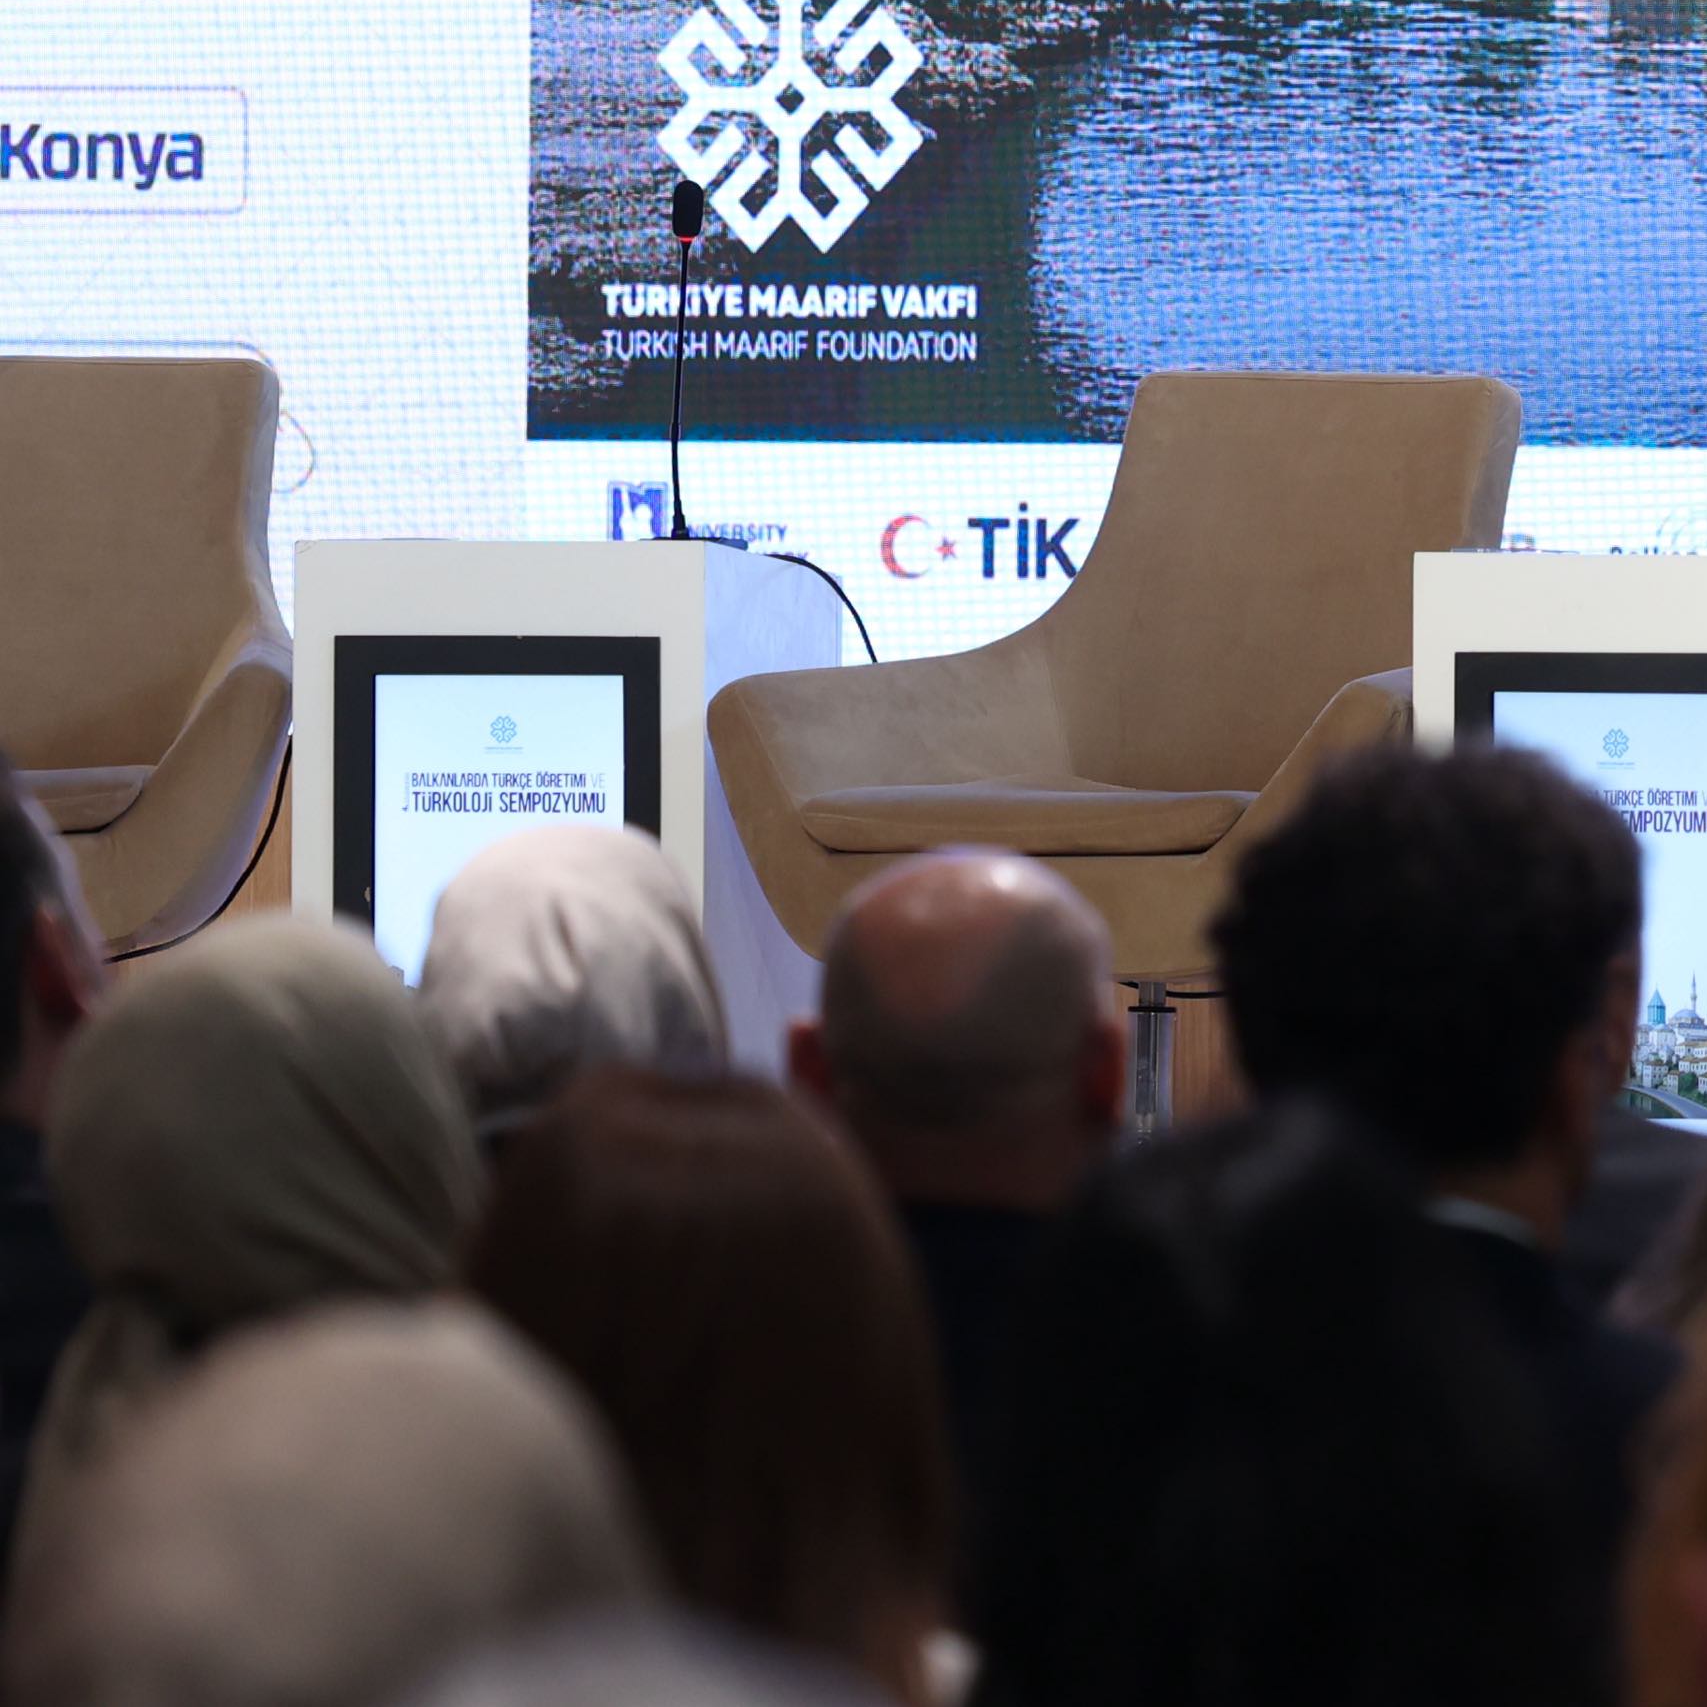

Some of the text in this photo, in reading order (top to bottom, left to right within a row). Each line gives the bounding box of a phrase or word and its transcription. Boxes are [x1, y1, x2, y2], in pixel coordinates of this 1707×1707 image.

[0, 123, 205, 191] Konya
[880, 283, 978, 319] VAKFI
[714, 329, 809, 361] MAARIF
[816, 329, 978, 362] FOUNDATION
[687, 523, 788, 543] NIVERSITY
[411, 772, 489, 788] BALKANLARDA
[412, 790, 493, 813] TÜRKOLOJİ
[499, 791, 606, 814] SEMPOZYUMU
